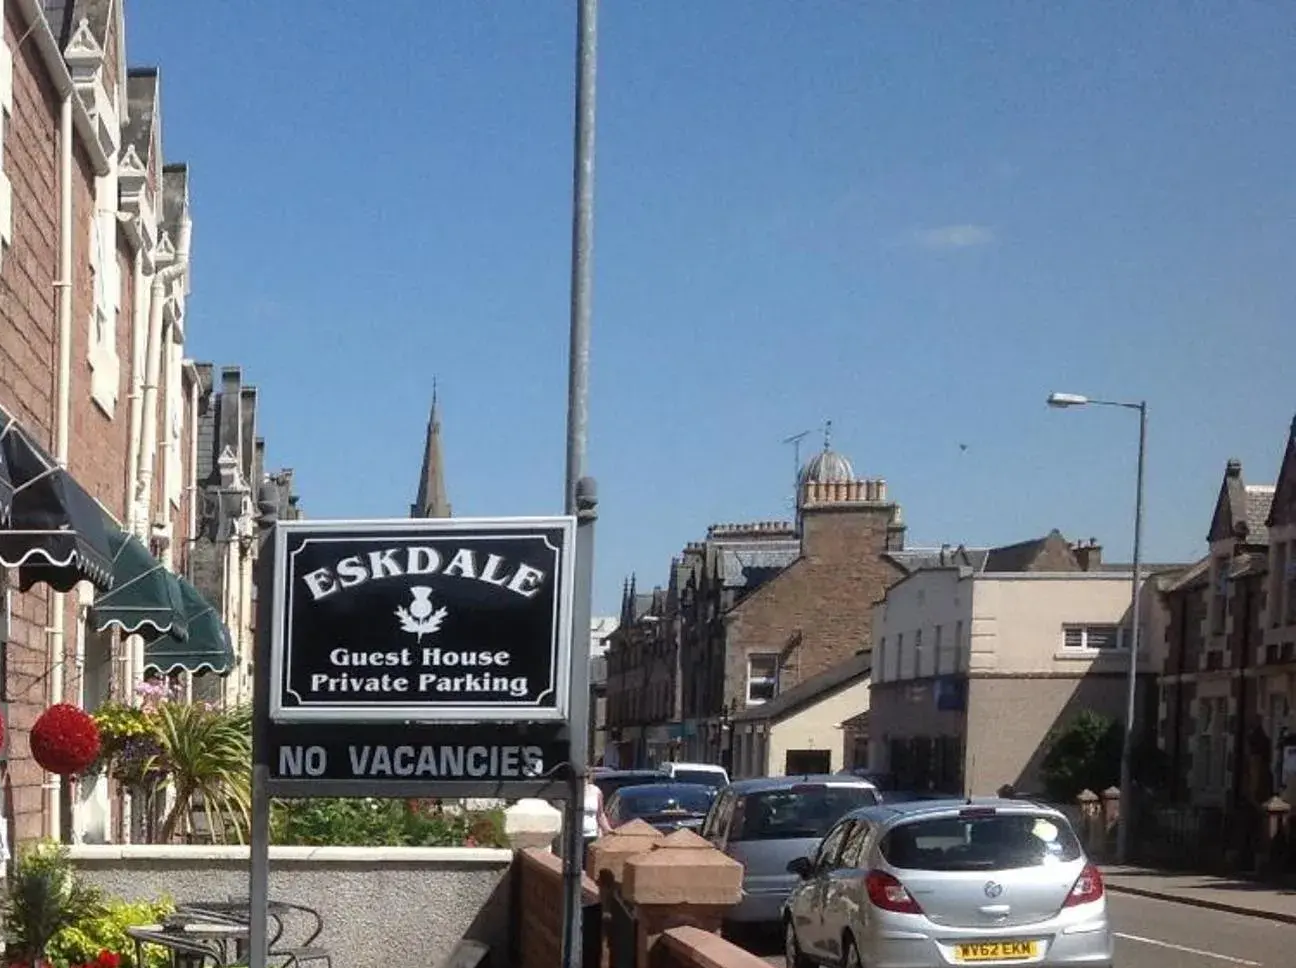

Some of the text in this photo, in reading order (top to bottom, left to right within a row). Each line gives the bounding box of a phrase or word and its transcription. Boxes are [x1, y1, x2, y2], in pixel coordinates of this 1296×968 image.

[303, 546, 544, 600] ESKDALE
[329, 648, 511, 666] Guest House
[311, 673, 528, 696] Private Parking
[278, 745, 543, 777] NO VACANCIES
